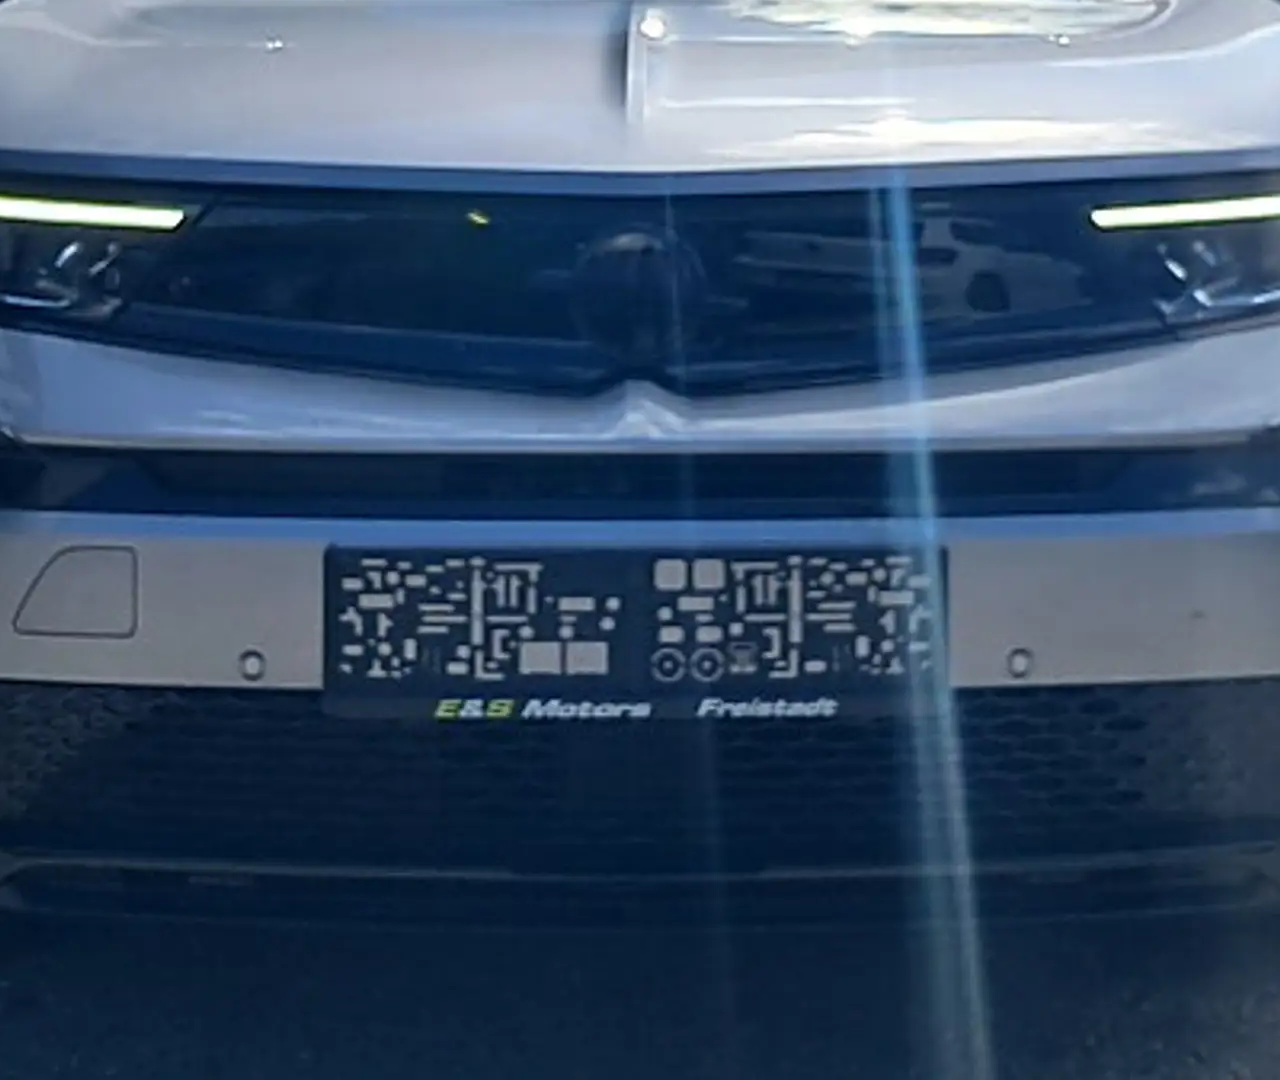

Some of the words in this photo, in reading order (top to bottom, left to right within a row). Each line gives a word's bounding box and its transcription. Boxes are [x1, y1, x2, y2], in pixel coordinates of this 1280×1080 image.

[434, 698, 515, 718] E&S
[521, 698, 652, 718] Motors
[696, 697, 840, 718] Freistadt
